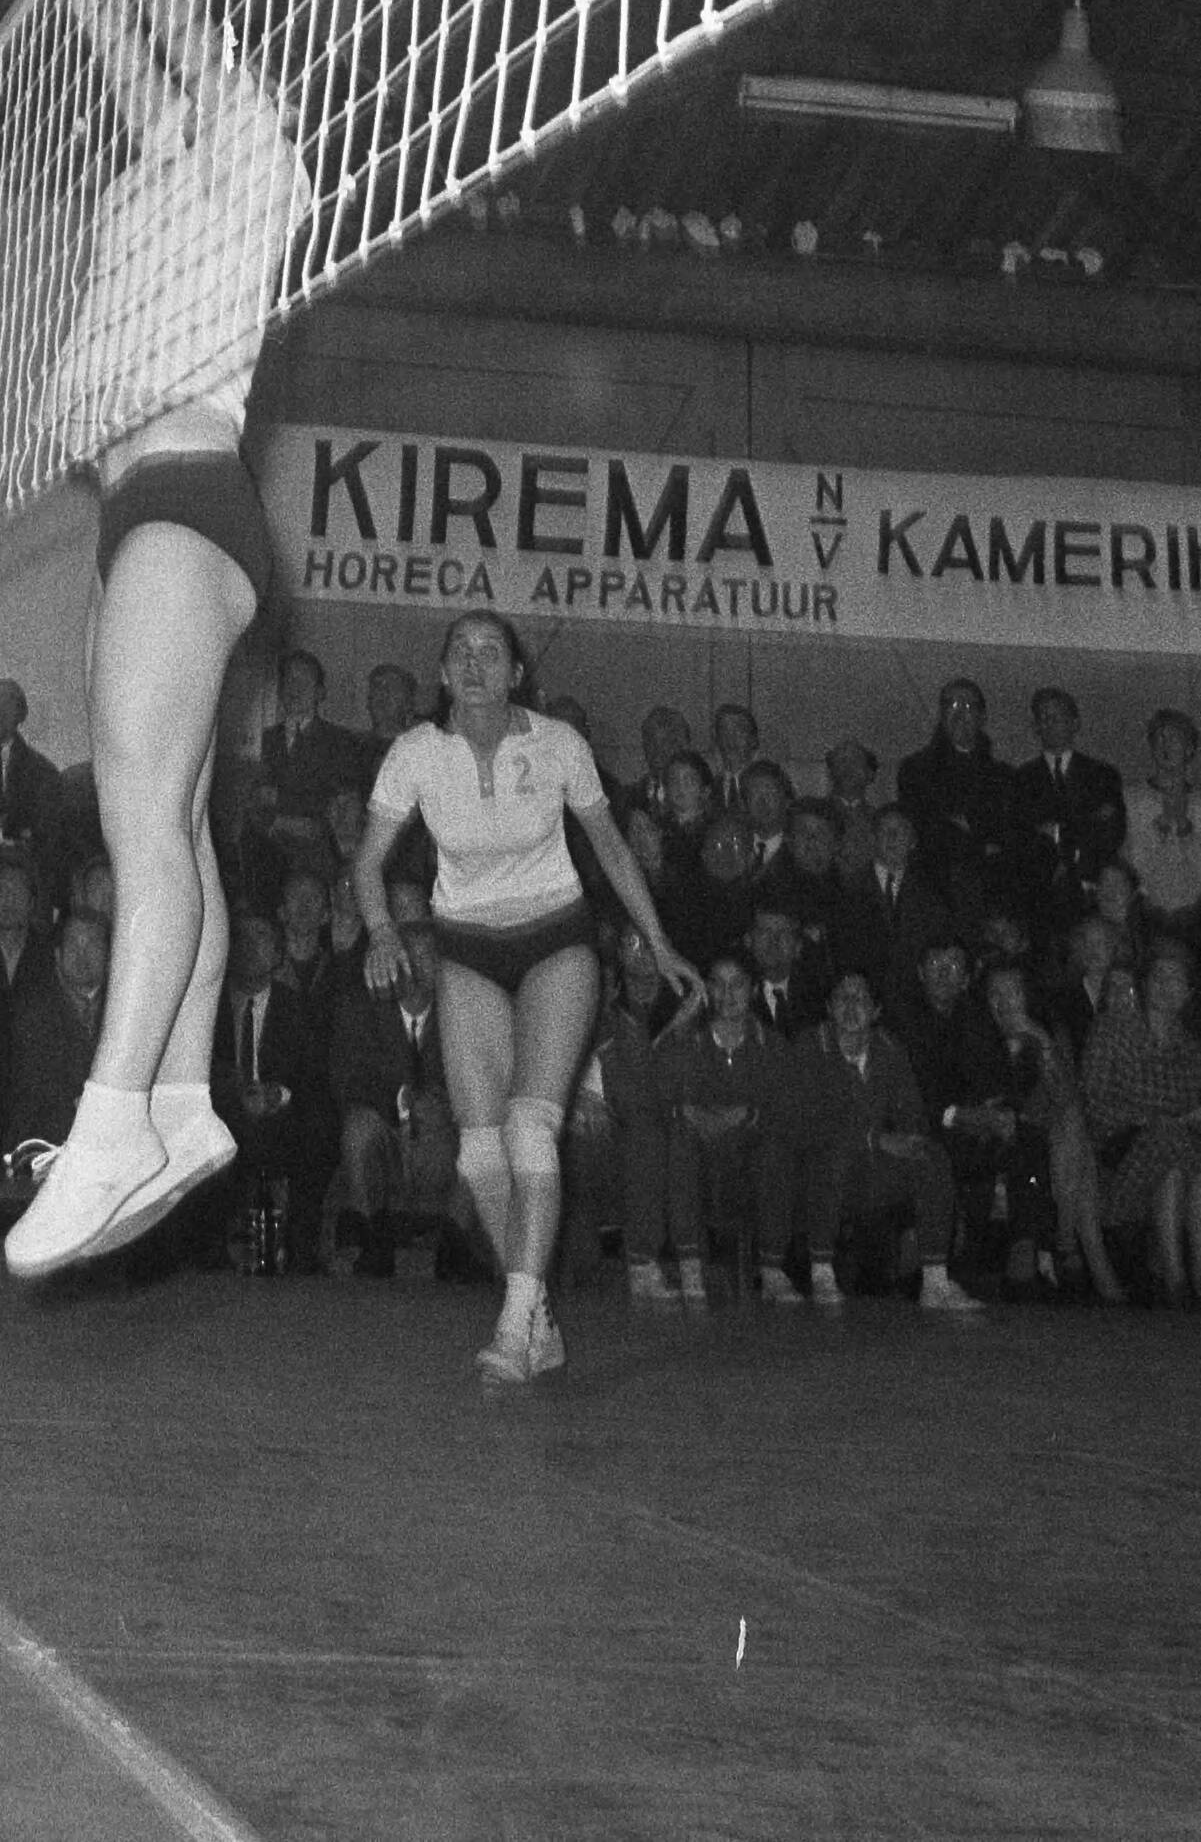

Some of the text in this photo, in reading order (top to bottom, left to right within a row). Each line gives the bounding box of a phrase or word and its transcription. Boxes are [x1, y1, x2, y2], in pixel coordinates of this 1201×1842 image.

[310, 439, 774, 567] KIREMA
[815, 472, 843, 512] N
[811, 531, 843, 570] V
[303, 549, 838, 621] HORECA APPARATUUR
[511, 752, 537, 795] 2
